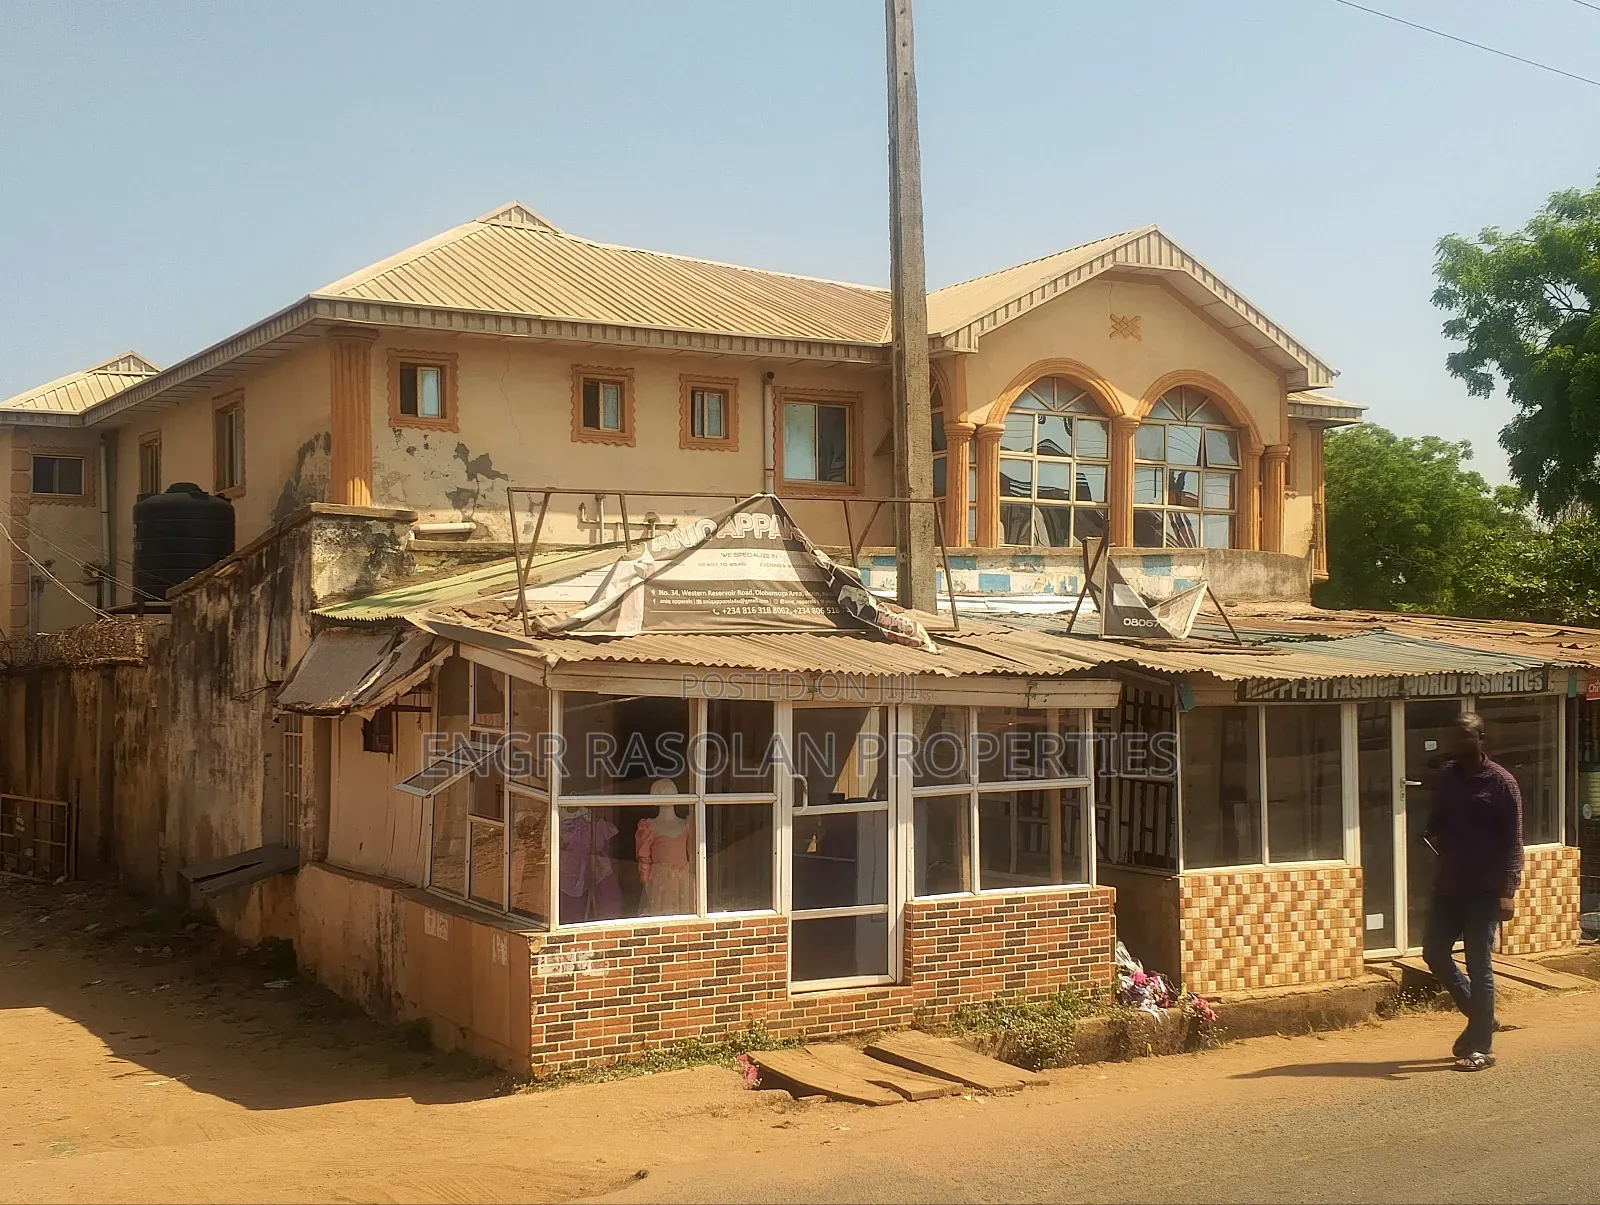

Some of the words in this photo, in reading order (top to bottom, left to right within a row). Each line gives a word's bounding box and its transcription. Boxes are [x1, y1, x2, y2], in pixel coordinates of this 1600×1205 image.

[671, 589, 680, 597] 34,
[737, 589, 755, 597] Road,
[722, 606, 740, 615] +234
[742, 606, 756, 614] 816
[758, 606, 772, 614] 318
[794, 606, 810, 615] +234
[811, 606, 824, 615] 806
[1332, 676, 1399, 699] FASHION
[1403, 673, 1457, 697] WORLD
[1460, 670, 1543, 694] COSMETICS
